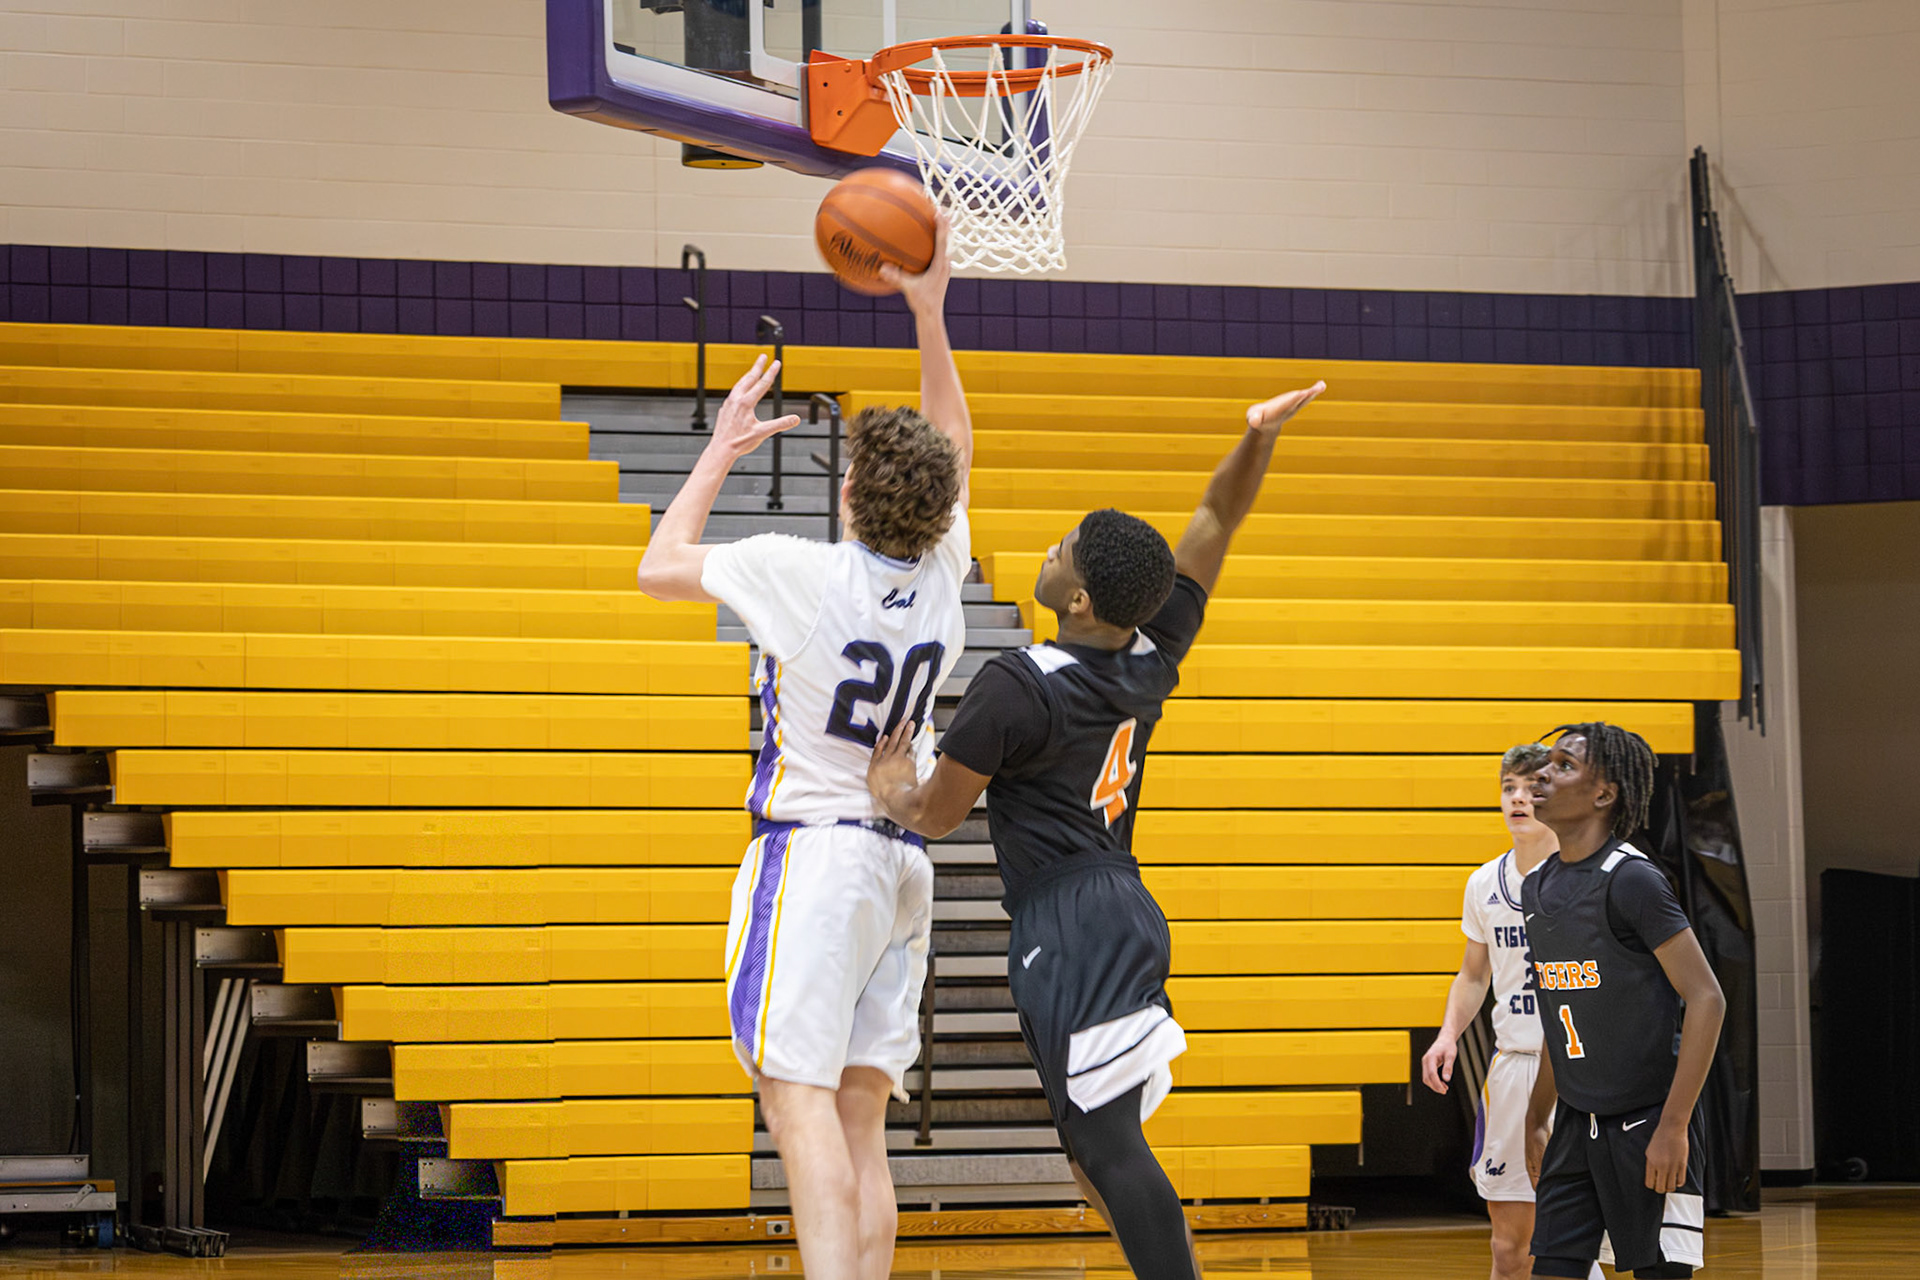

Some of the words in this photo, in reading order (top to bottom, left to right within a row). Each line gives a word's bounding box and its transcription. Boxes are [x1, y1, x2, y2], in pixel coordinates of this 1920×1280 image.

[882, 587, 917, 610] Cal
[825, 640, 945, 748] 20
[1090, 717, 1137, 830] 4
[1559, 1004, 1586, 1059] 1
